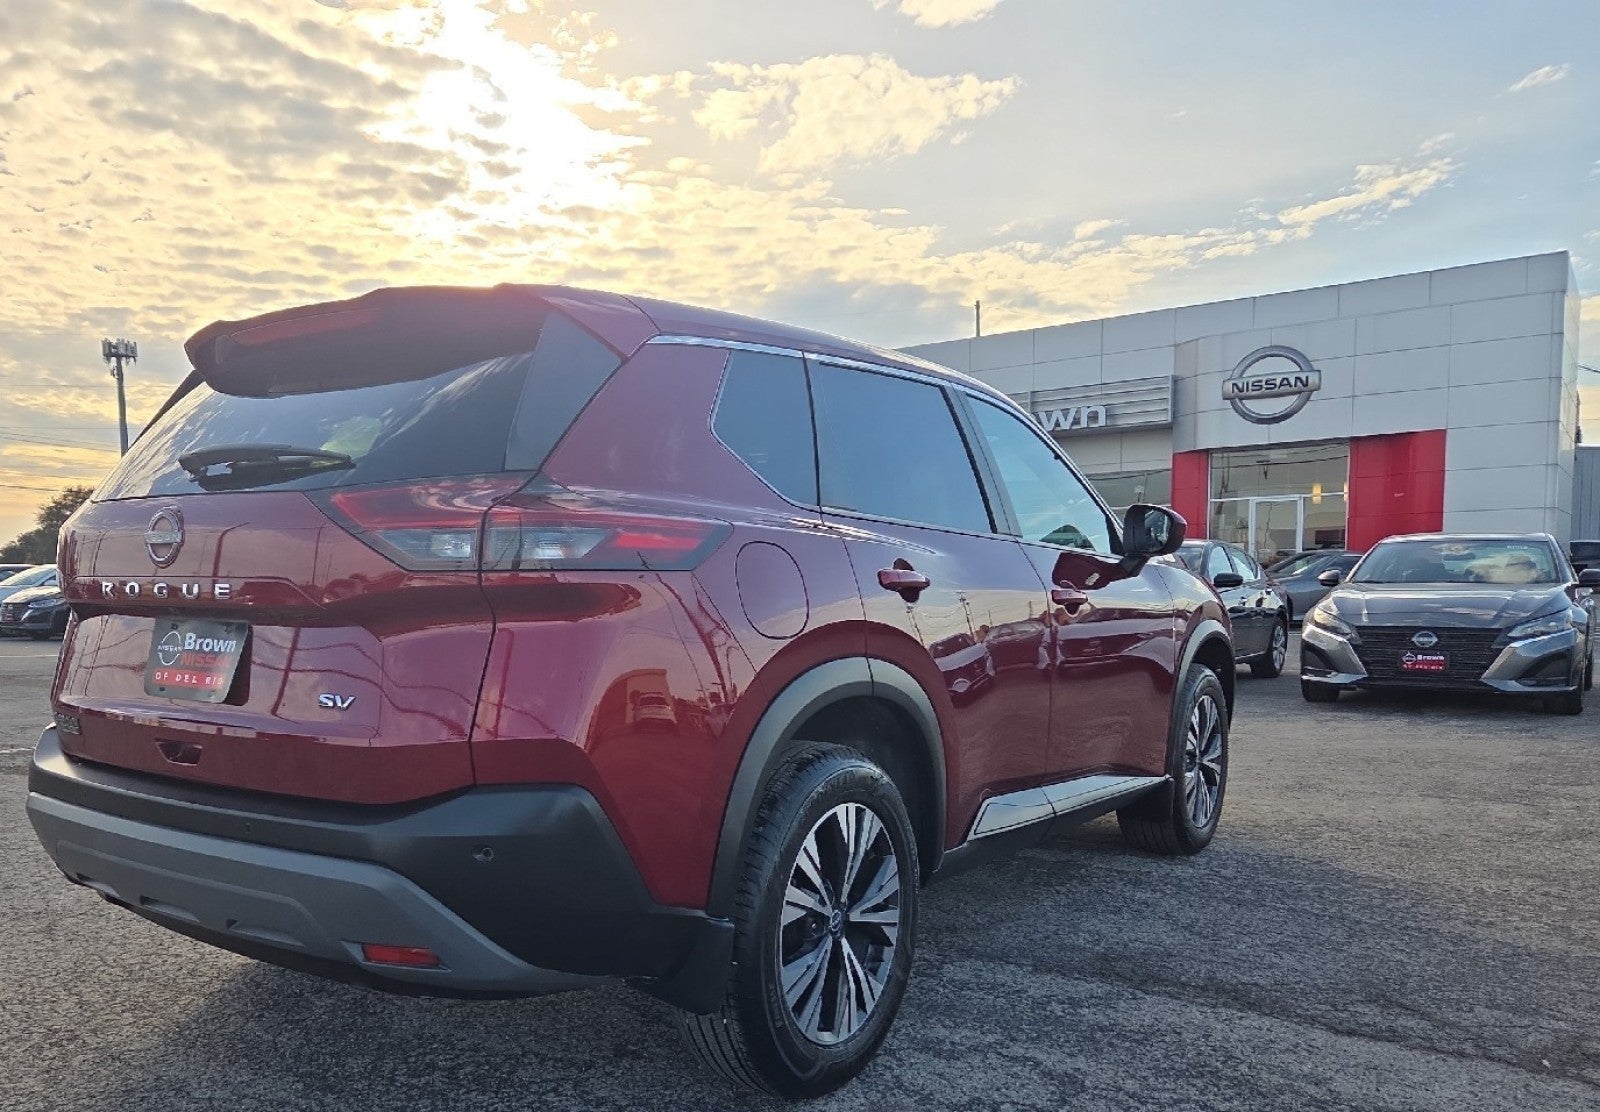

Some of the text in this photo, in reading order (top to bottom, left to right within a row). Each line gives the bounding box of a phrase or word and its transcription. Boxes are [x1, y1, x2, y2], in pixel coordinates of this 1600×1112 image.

[1231, 374, 1309, 394] NISSAN
[1031, 405, 1106, 431] wn
[101, 581, 232, 599] ROGUE
[184, 632, 237, 652] Brown
[155, 672, 224, 685] OF DEL RIO
[318, 693, 355, 710] SV
